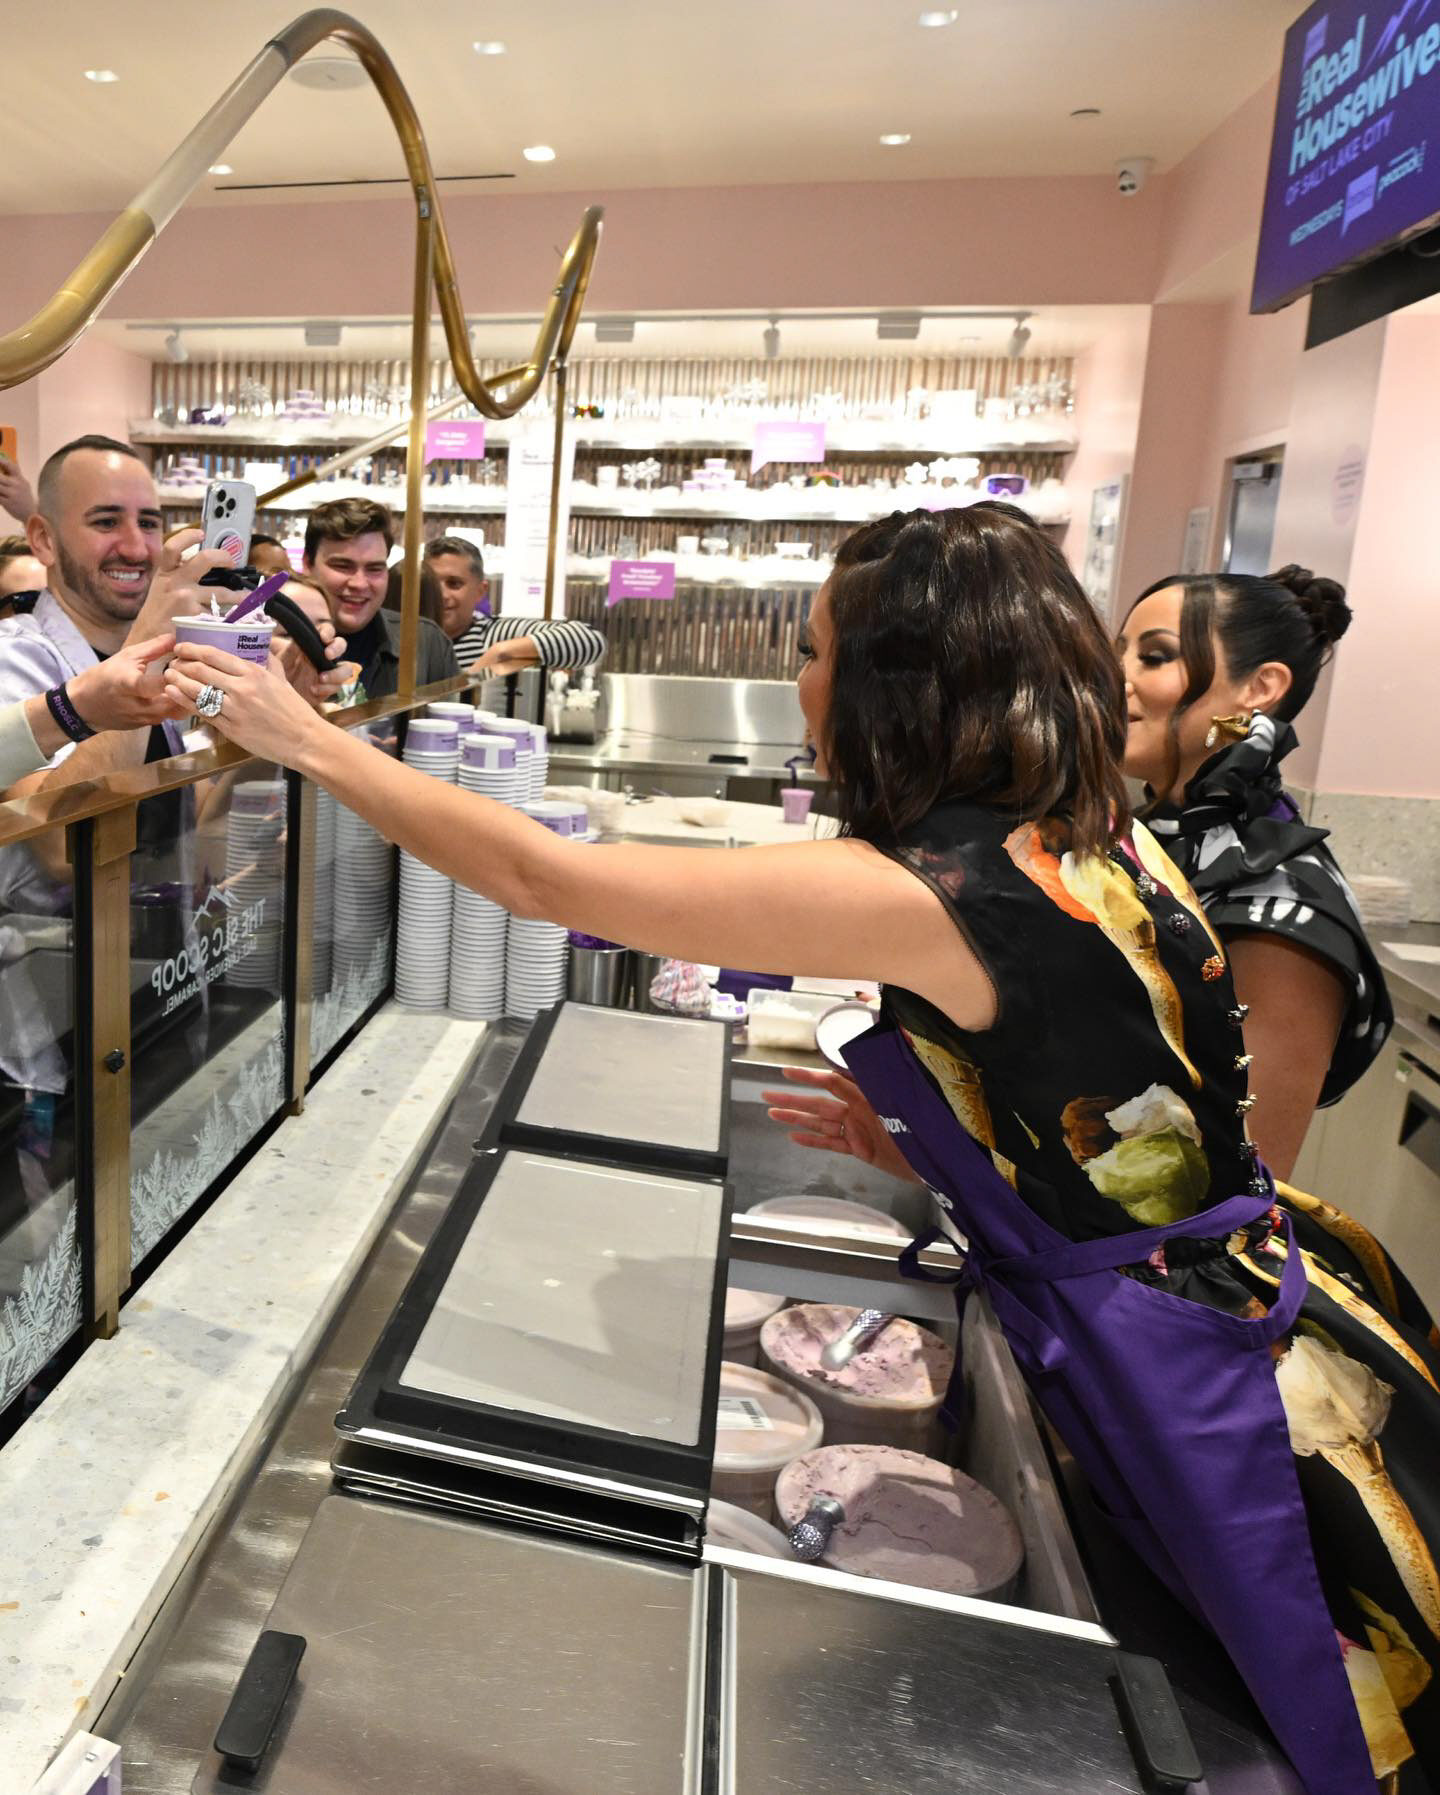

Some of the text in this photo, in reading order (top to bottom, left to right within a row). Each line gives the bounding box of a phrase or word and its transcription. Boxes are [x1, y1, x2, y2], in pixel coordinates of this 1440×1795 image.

[1289, 23, 1440, 175] Housewive
[1311, 15, 1366, 105] Real
[1301, 160, 1329, 196] SALT
[1328, 136, 1361, 176] LAKE
[1362, 111, 1394, 152] CITY
[241, 635, 258, 643] Real
[53, 695, 78, 730] RHOSLC
